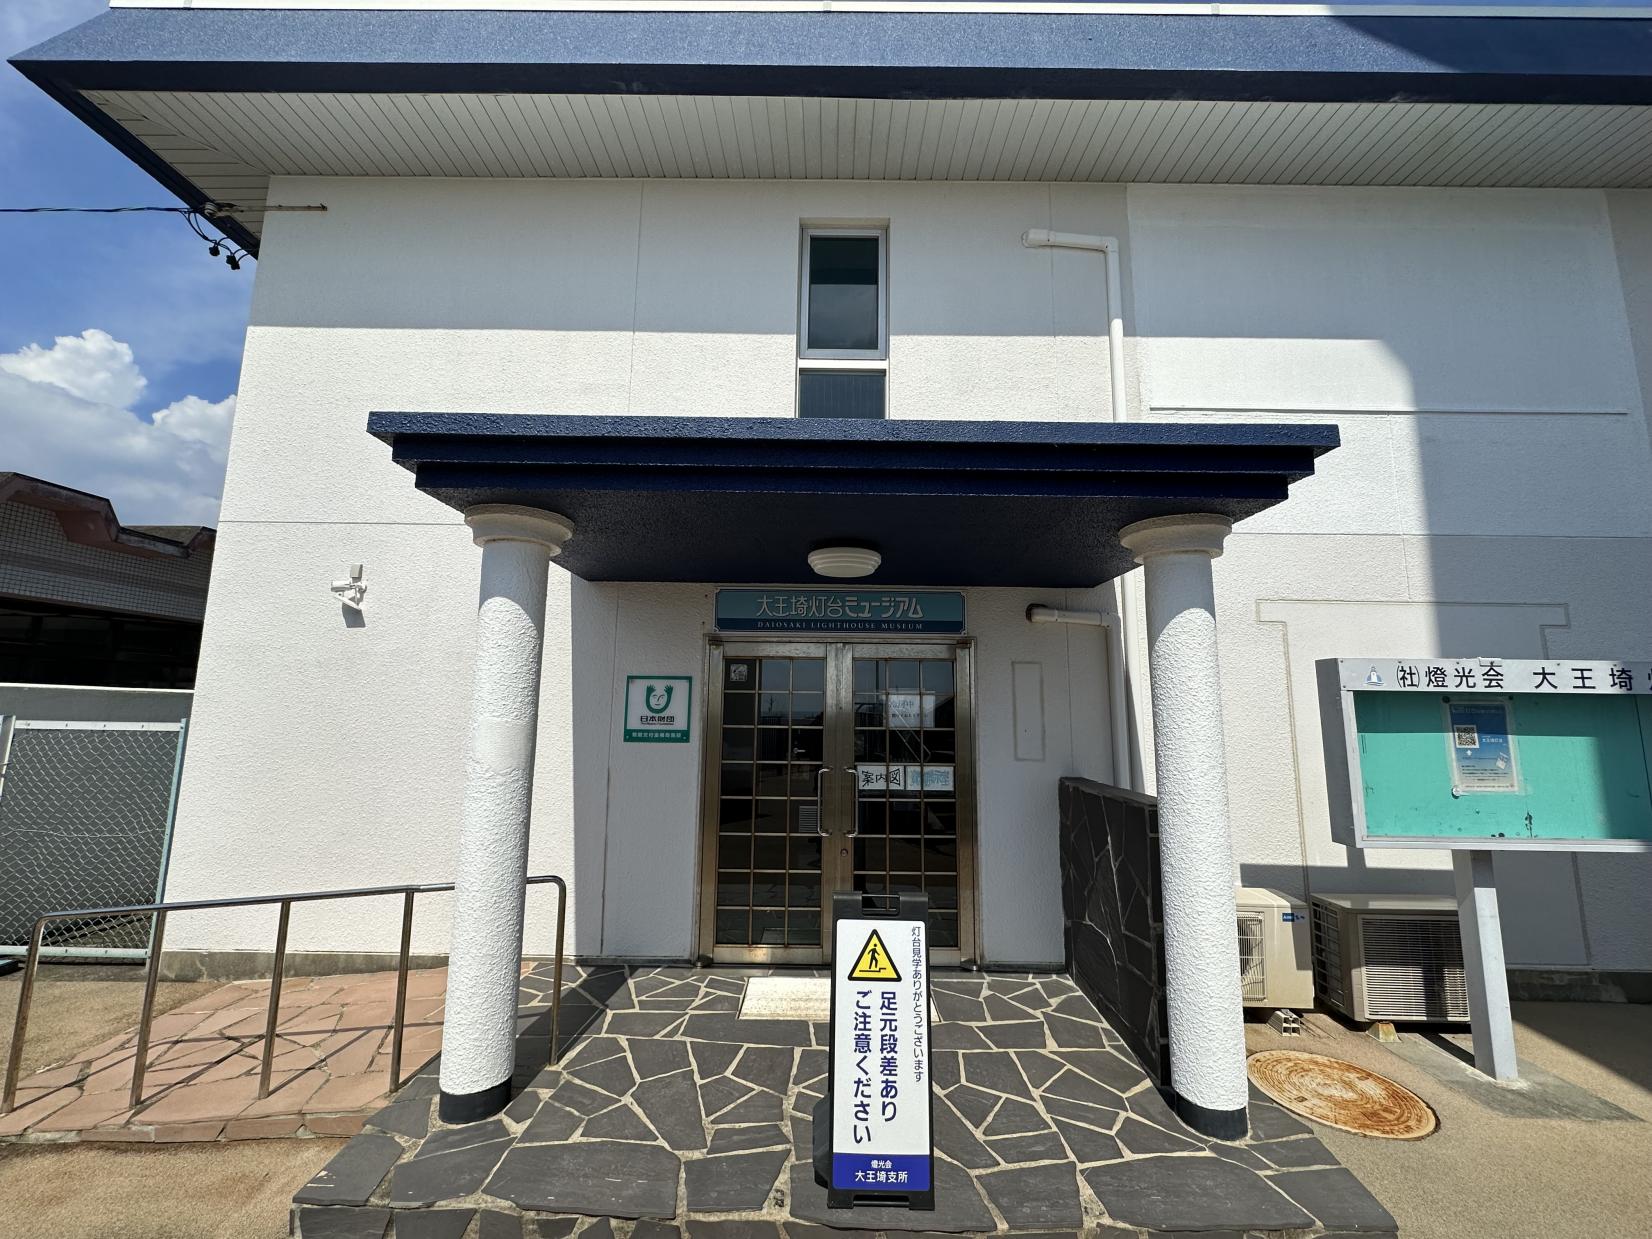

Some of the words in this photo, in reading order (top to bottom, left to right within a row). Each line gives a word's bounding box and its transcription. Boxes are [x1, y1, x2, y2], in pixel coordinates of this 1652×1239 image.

[756, 594, 924, 618] 大王埼灯台ミュージアム
[757, 621, 807, 629] DAIOSAKI
[811, 621, 876, 630] LIGHTHOUSE
[861, 768, 901, 787] 案内図
[911, 926, 924, 1083] 灯台見学ありがとうございます
[853, 990, 872, 1144] ご注意ください
[879, 991, 898, 1122] 足元段差あり
[855, 1170, 908, 1183] 大王埼支所
